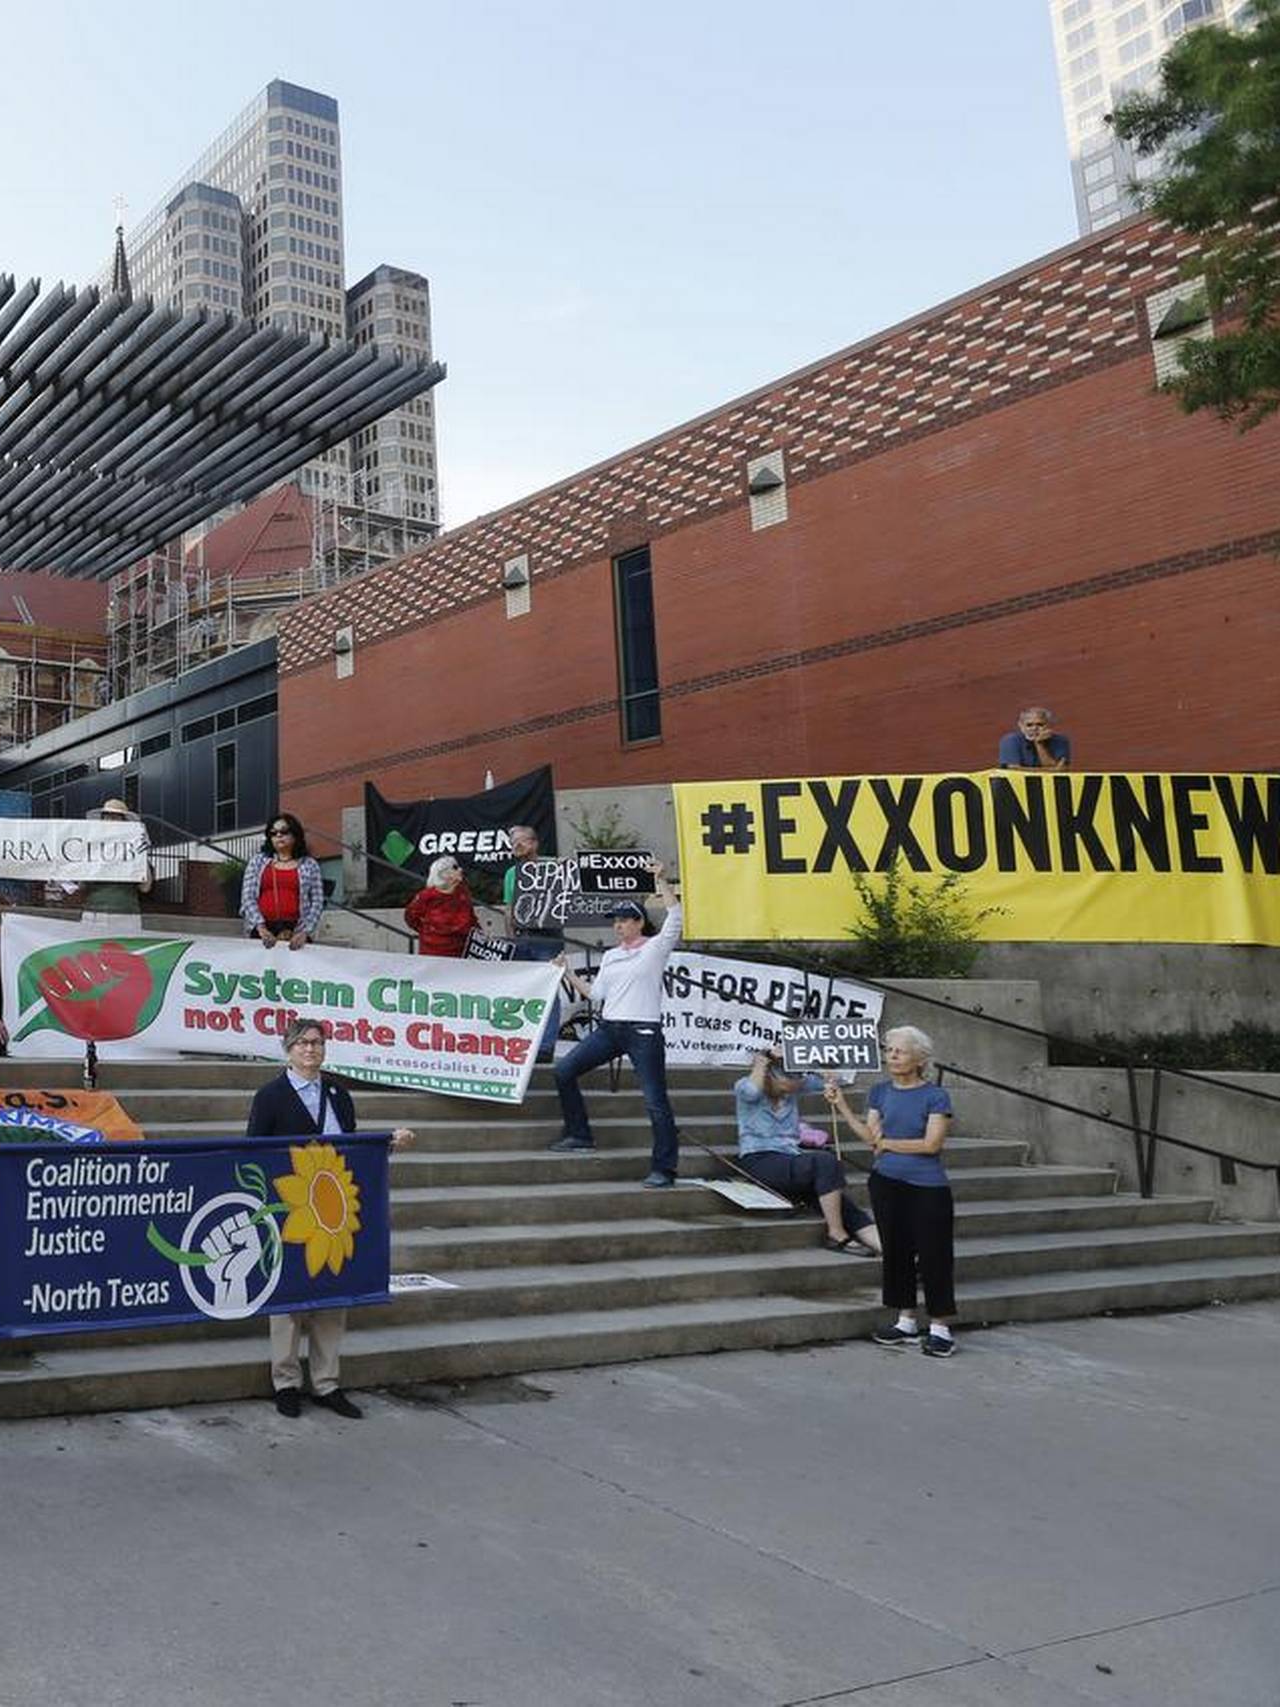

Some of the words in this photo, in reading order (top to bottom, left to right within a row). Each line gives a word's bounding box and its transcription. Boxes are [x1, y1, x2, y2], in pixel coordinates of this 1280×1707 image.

[701, 774, 1280, 875] #EXXONKNEW
[184, 960, 355, 1009] System
[701, 969, 759, 1006] FOR
[768, 979, 867, 1020] PEACE
[184, 1005, 246, 1036] not
[251, 1005, 396, 1048] Clate
[407, 1026, 532, 1065] Chang
[681, 1012, 733, 1033] Texas
[738, 1017, 783, 1047] Chap
[784, 1024, 832, 1042] SAVE
[835, 1023, 877, 1042] OUR
[364, 1055, 381, 1066] an
[385, 1057, 480, 1076] ecosocialist
[482, 1065, 521, 1077] coali
[793, 1045, 870, 1066] EARTH
[26, 1155, 132, 1188] Coalition
[136, 1156, 170, 1185] for
[26, 1186, 194, 1221] Environmental
[24, 1226, 106, 1257] Justice
[23, 1279, 101, 1314] -North
[106, 1279, 170, 1306] Texas
